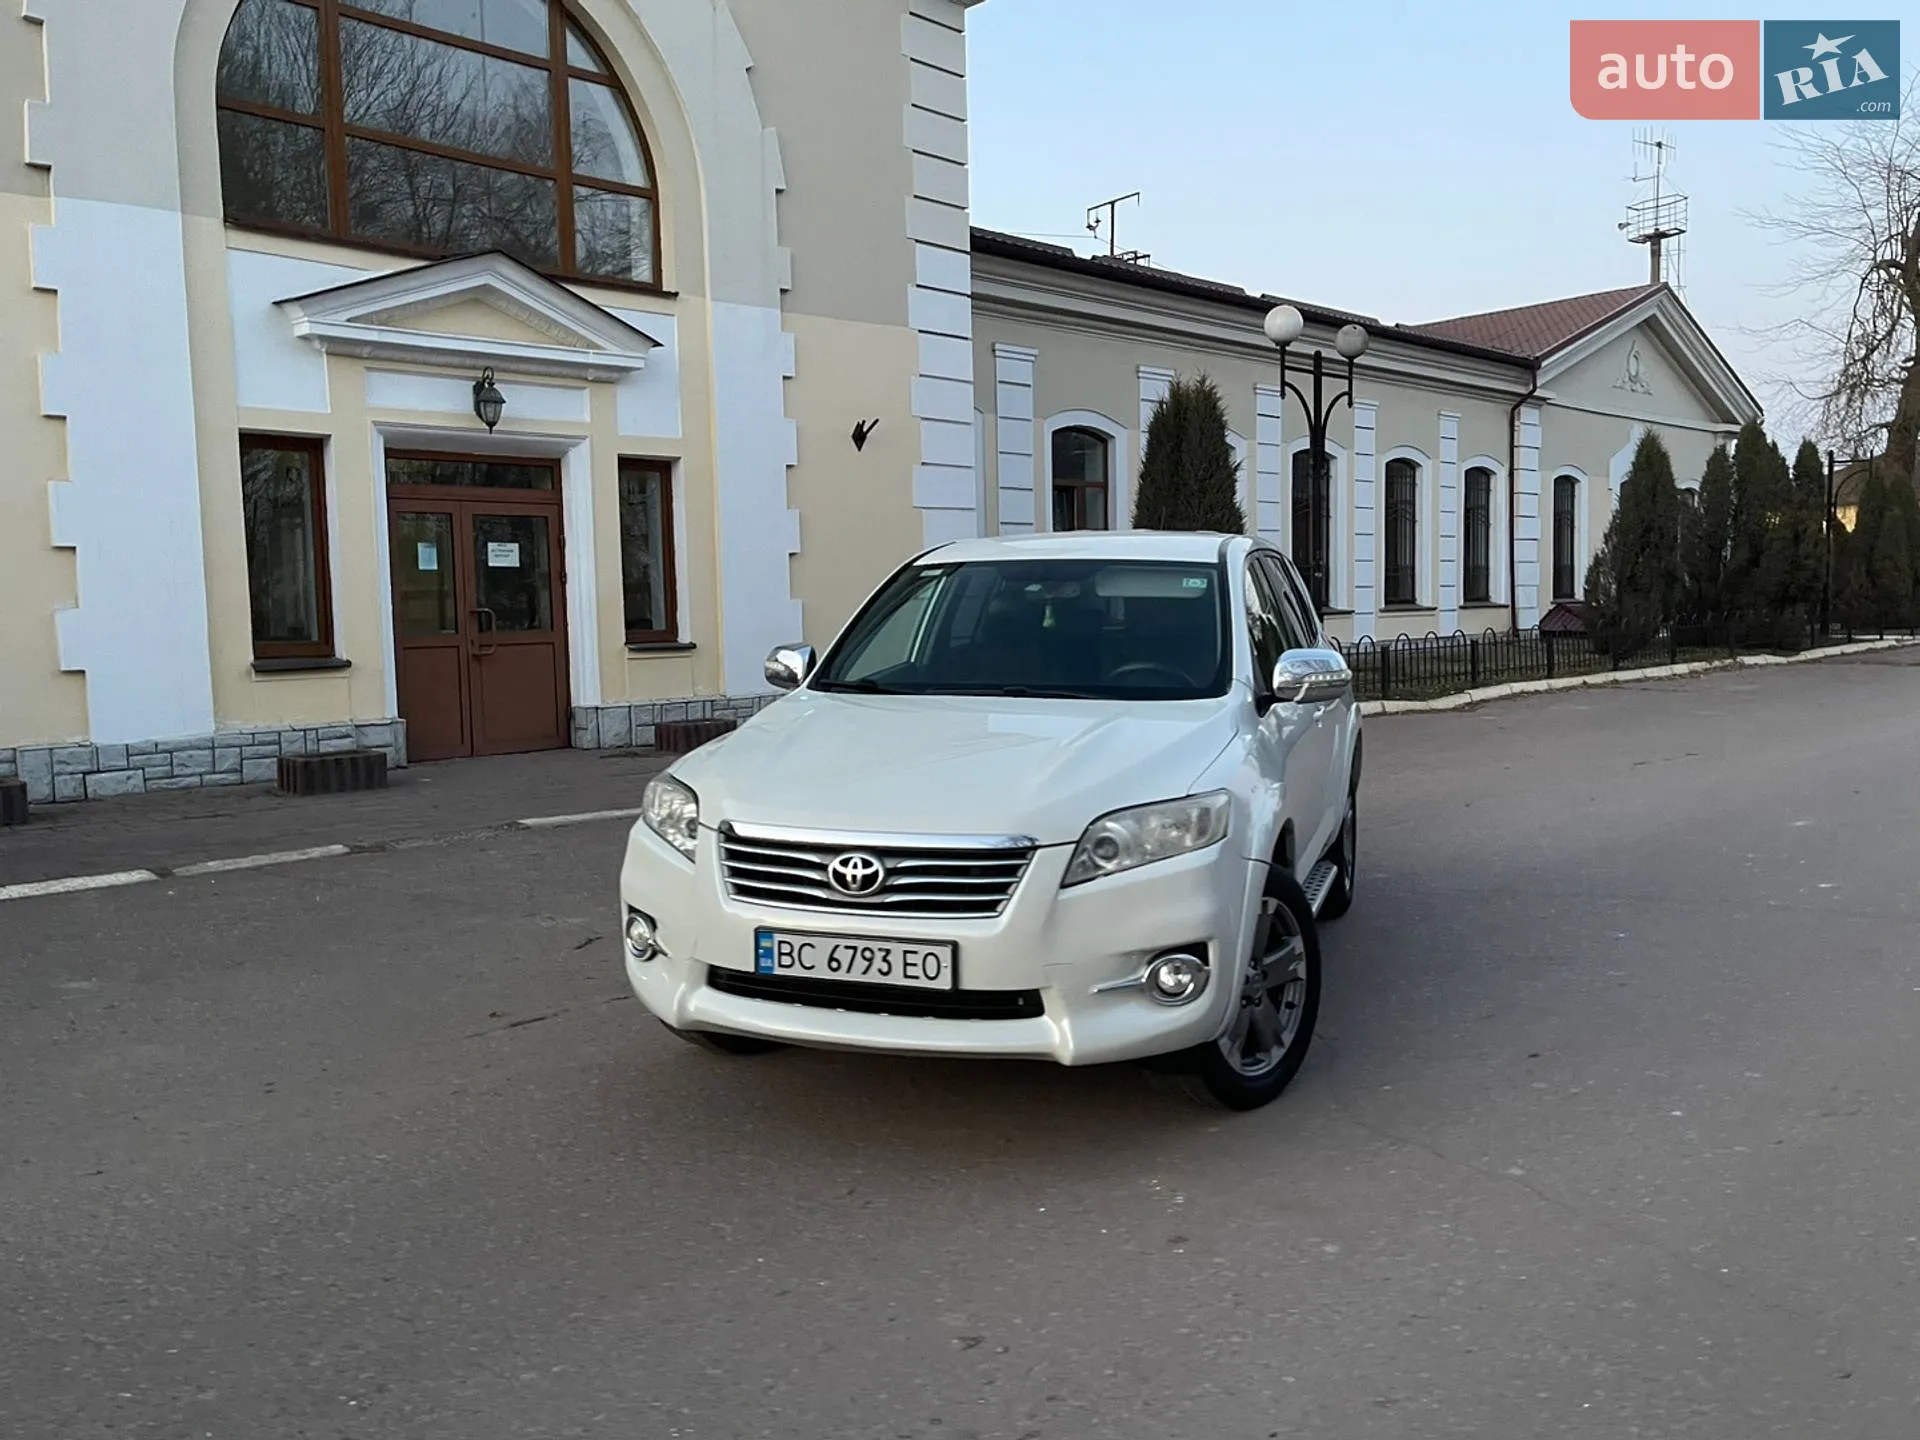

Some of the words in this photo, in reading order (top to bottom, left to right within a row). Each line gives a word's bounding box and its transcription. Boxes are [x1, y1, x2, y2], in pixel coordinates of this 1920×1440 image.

[777, 940, 816, 970] BC
[827, 944, 893, 977] 6793
[903, 950, 941, 981] EO
